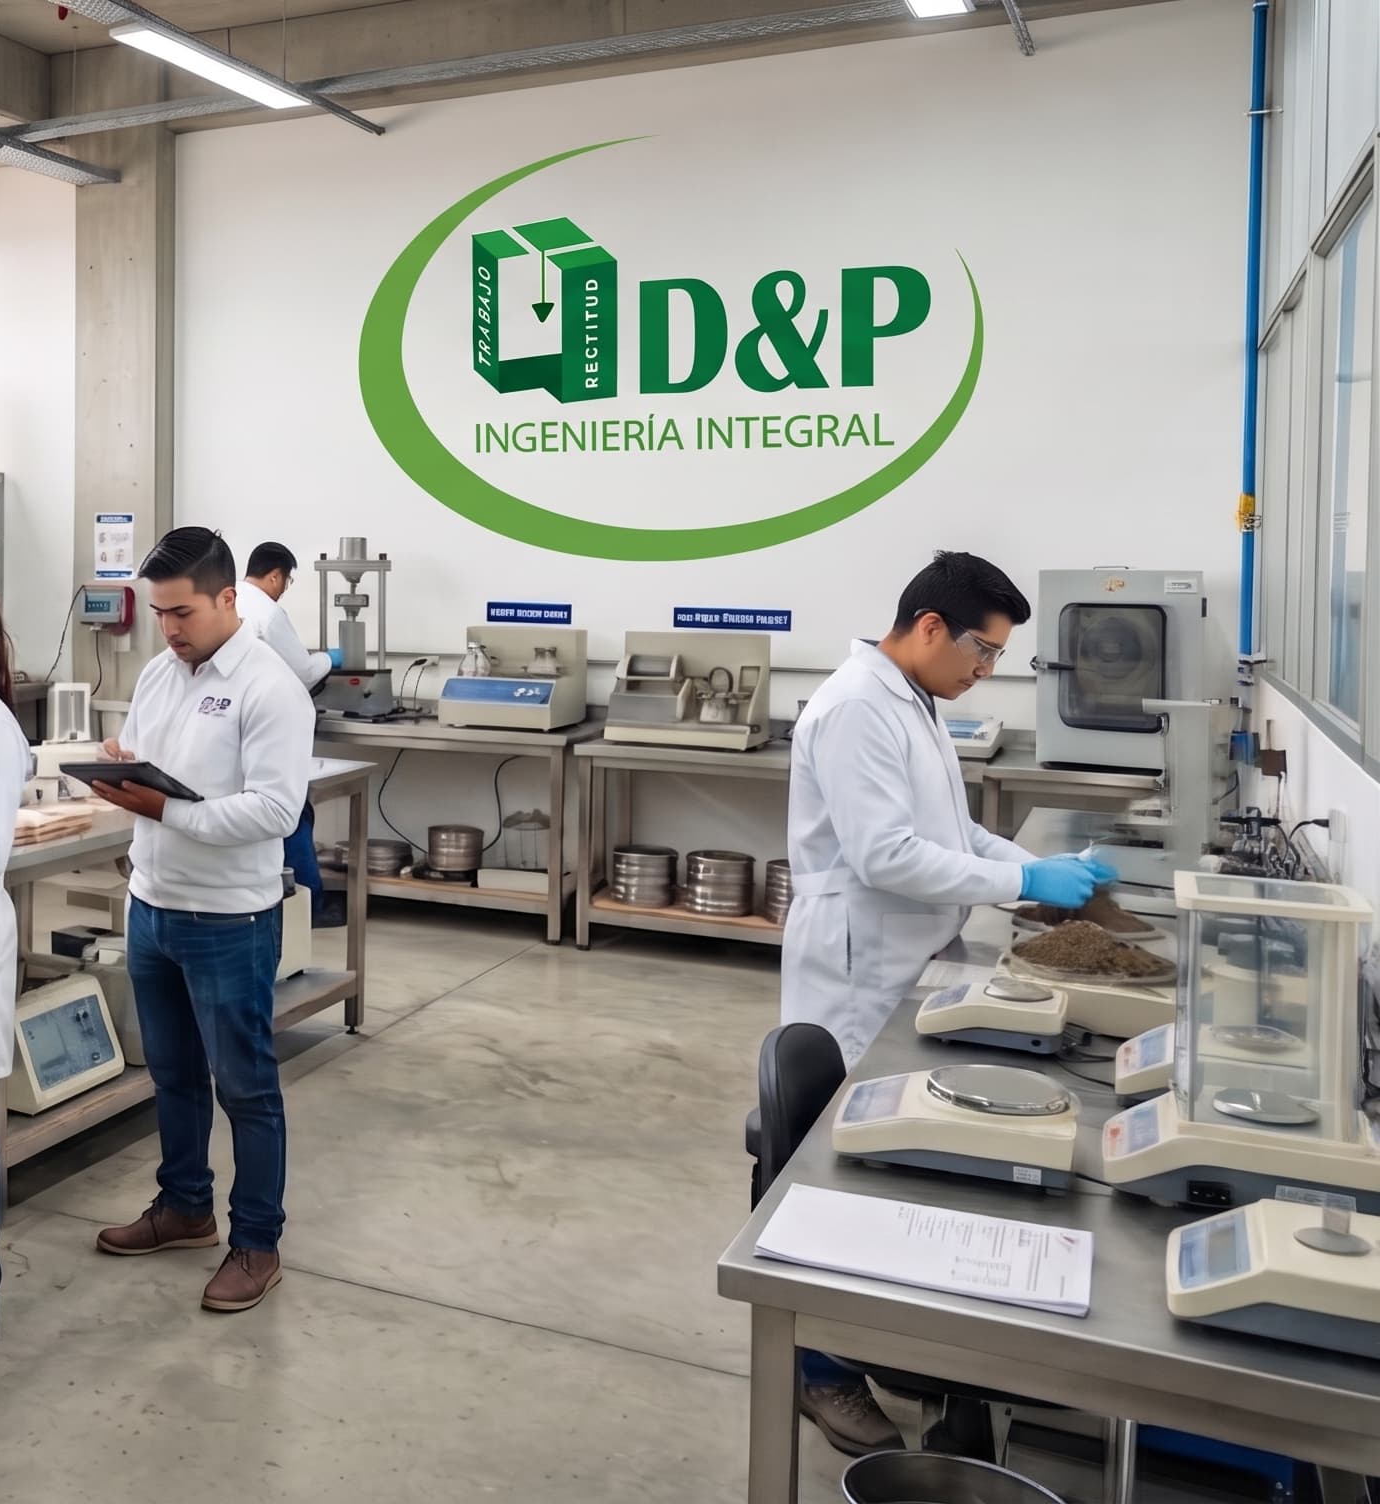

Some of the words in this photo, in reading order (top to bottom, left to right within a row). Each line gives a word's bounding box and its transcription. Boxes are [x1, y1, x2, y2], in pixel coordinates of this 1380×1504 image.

[477, 265, 492, 367] TRABAJO
[584, 277, 599, 389] RECTITUD
[639, 265, 931, 394] D&P
[475, 413, 684, 453] INGENIERÍA
[696, 412, 895, 449] INTEGRAL
